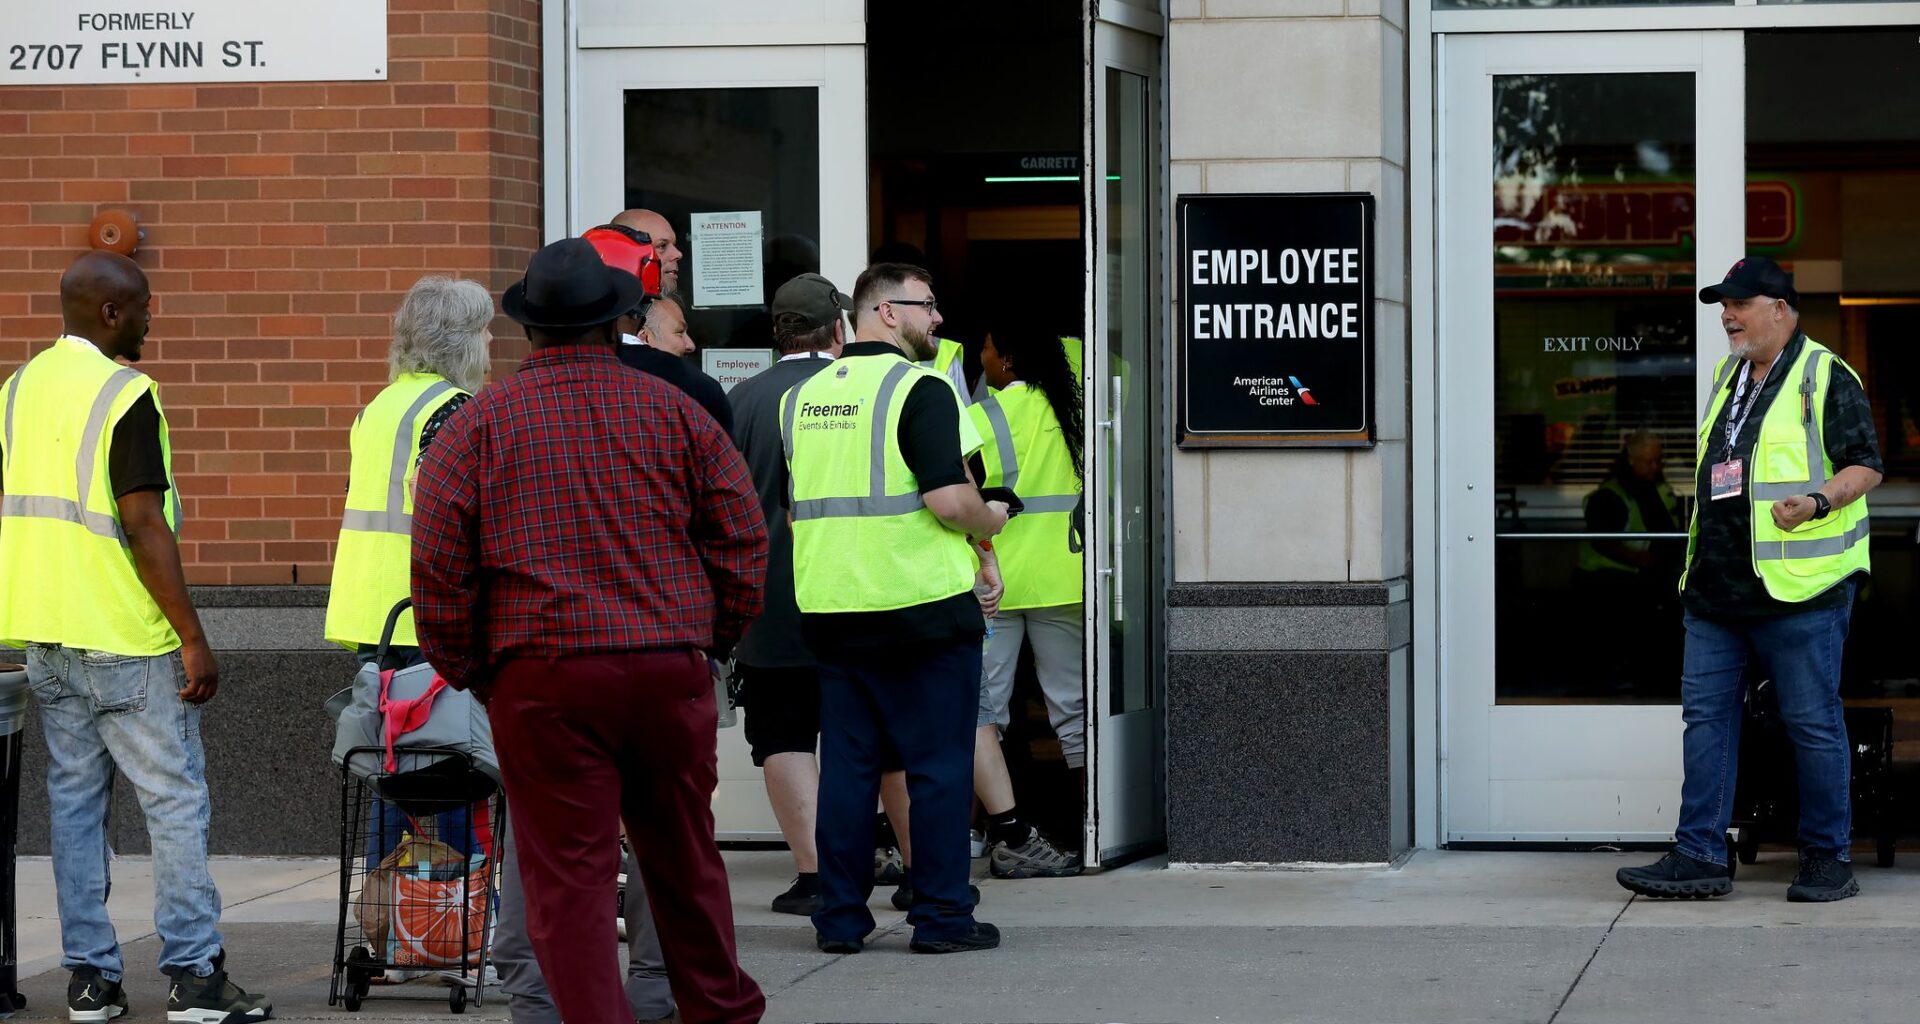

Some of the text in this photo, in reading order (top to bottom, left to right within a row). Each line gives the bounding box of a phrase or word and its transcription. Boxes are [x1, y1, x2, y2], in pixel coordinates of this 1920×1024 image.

[78, 12, 195, 31] FORMERLY
[9, 40, 266, 71] 2707 FLYNN ST.
[1020, 156, 1078, 169] GARRETT
[706, 222, 746, 230] ATTENTION
[1192, 248, 1359, 285] EMPLOYEE
[1193, 303, 1358, 339] ENTRANCE
[1544, 336, 1643, 352] EXIT ONLY
[716, 360, 760, 369] Employee
[1233, 376, 1284, 386] American
[1249, 386, 1289, 396] Airlines
[1259, 396, 1294, 406] Center
[800, 402, 859, 417] Freeman
[799, 421, 821, 431] Events
[822, 420, 829, 430] &
